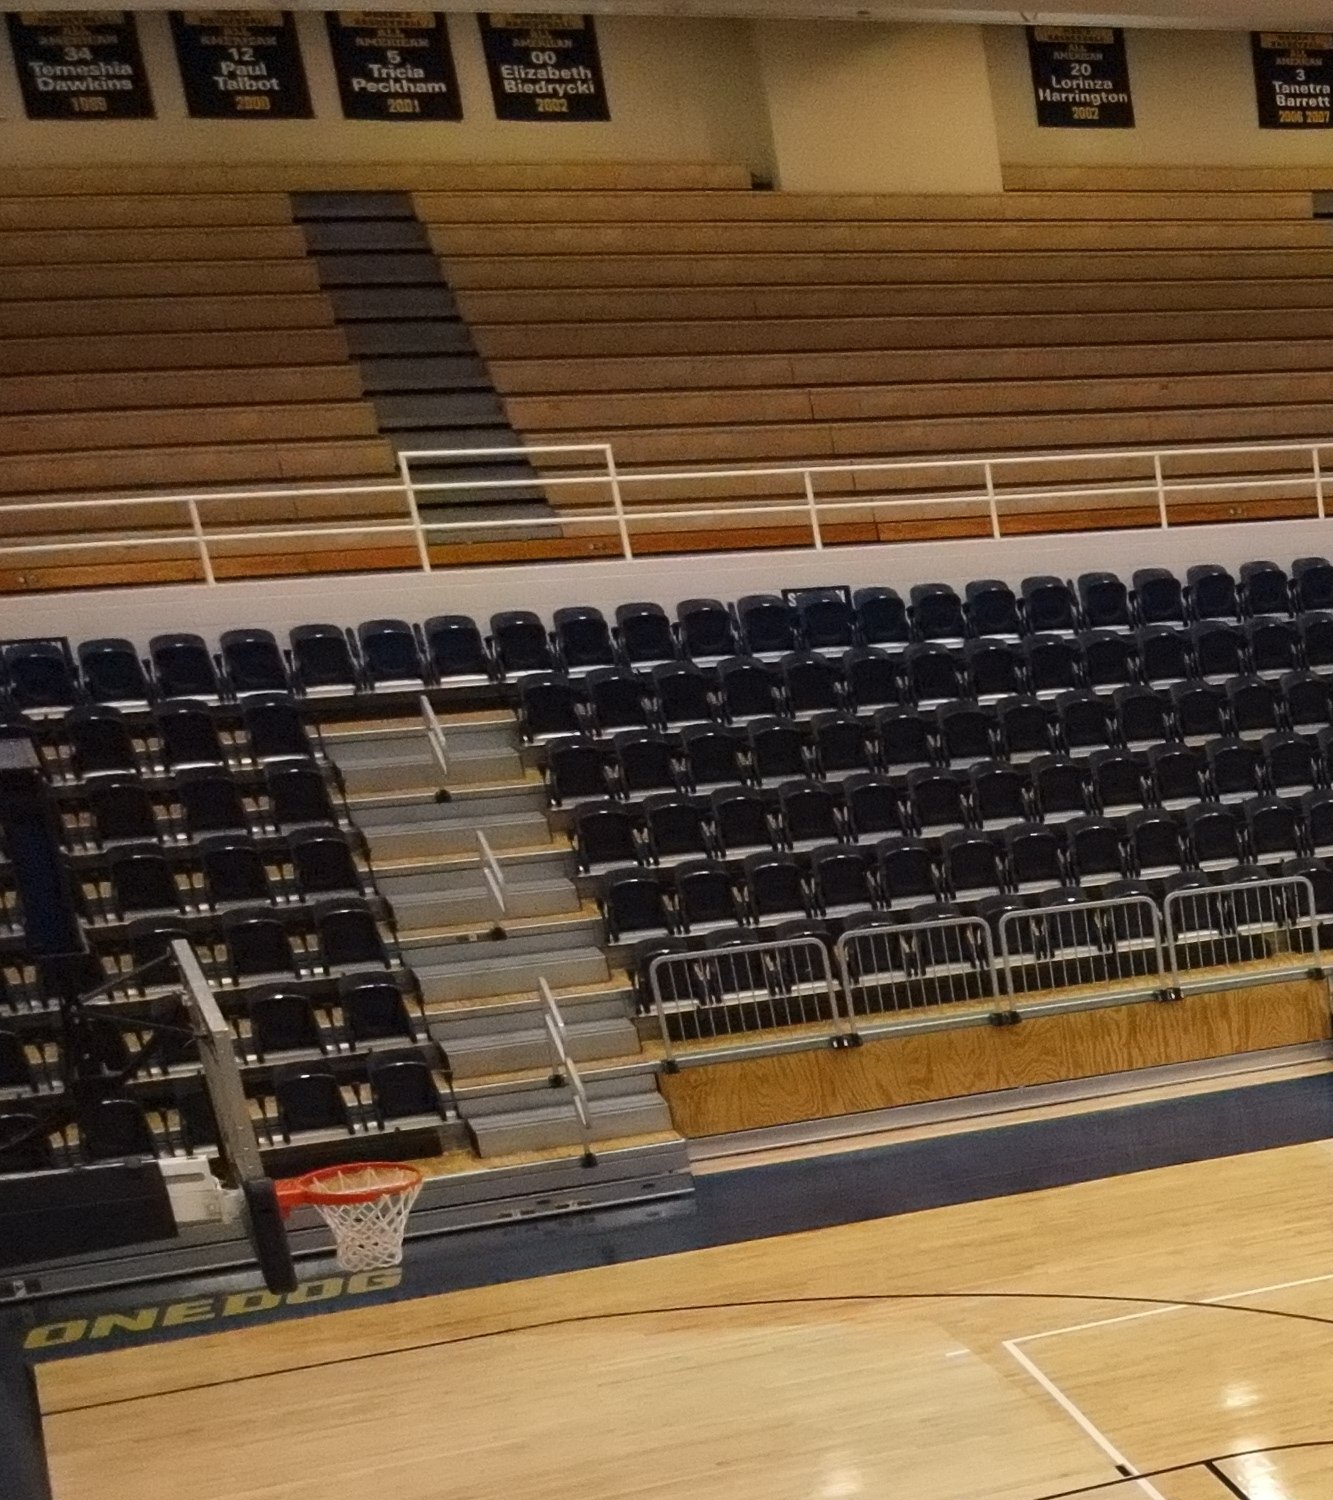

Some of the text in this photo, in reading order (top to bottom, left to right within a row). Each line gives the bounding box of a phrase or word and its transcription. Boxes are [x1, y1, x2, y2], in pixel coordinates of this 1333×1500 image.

[64, 47, 93, 61] 34
[228, 47, 256, 61] 12
[387, 50, 401, 64] 5
[220, 62, 268, 76] Paul
[368, 64, 425, 79] Tricia
[501, 65, 592, 80] Elizabeth
[1070, 63, 1092, 77] 20
[1296, 69, 1305, 81] 3
[37, 77, 133, 91] Dawkins
[213, 76, 280, 91] Talbot
[352, 79, 447, 93] Peckham
[1051, 76, 1113, 90] Lorinza
[1038, 89, 1128, 106] Harrington
[1275, 95, 1331, 108] Barrett
